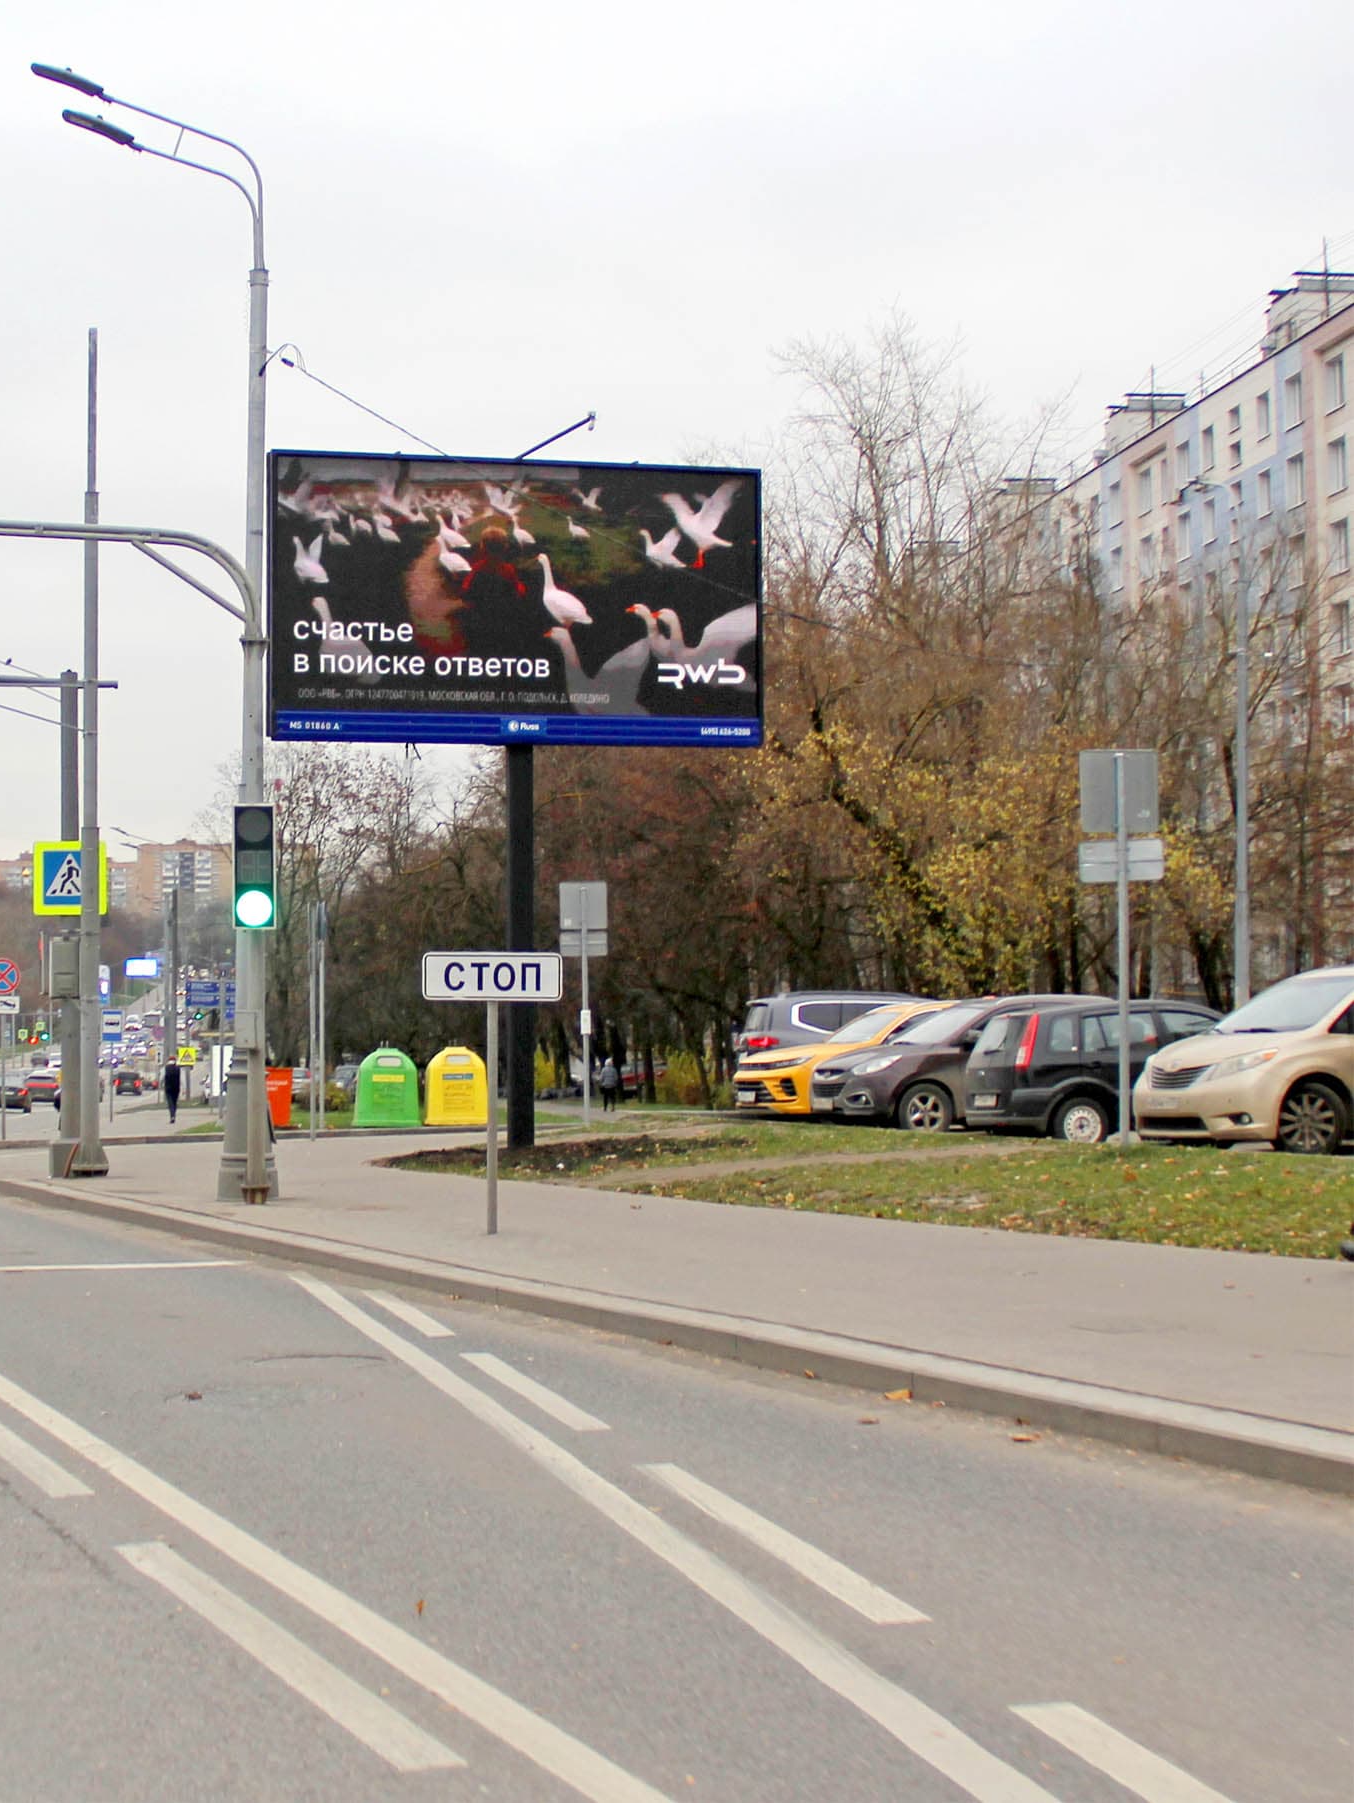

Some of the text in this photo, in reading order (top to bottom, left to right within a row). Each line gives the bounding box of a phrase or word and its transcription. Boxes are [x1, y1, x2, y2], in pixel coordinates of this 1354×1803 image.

[293, 620, 414, 642] счастье
[293, 654, 551, 678] в поиске ответов
[444, 962, 541, 992] СТОП
